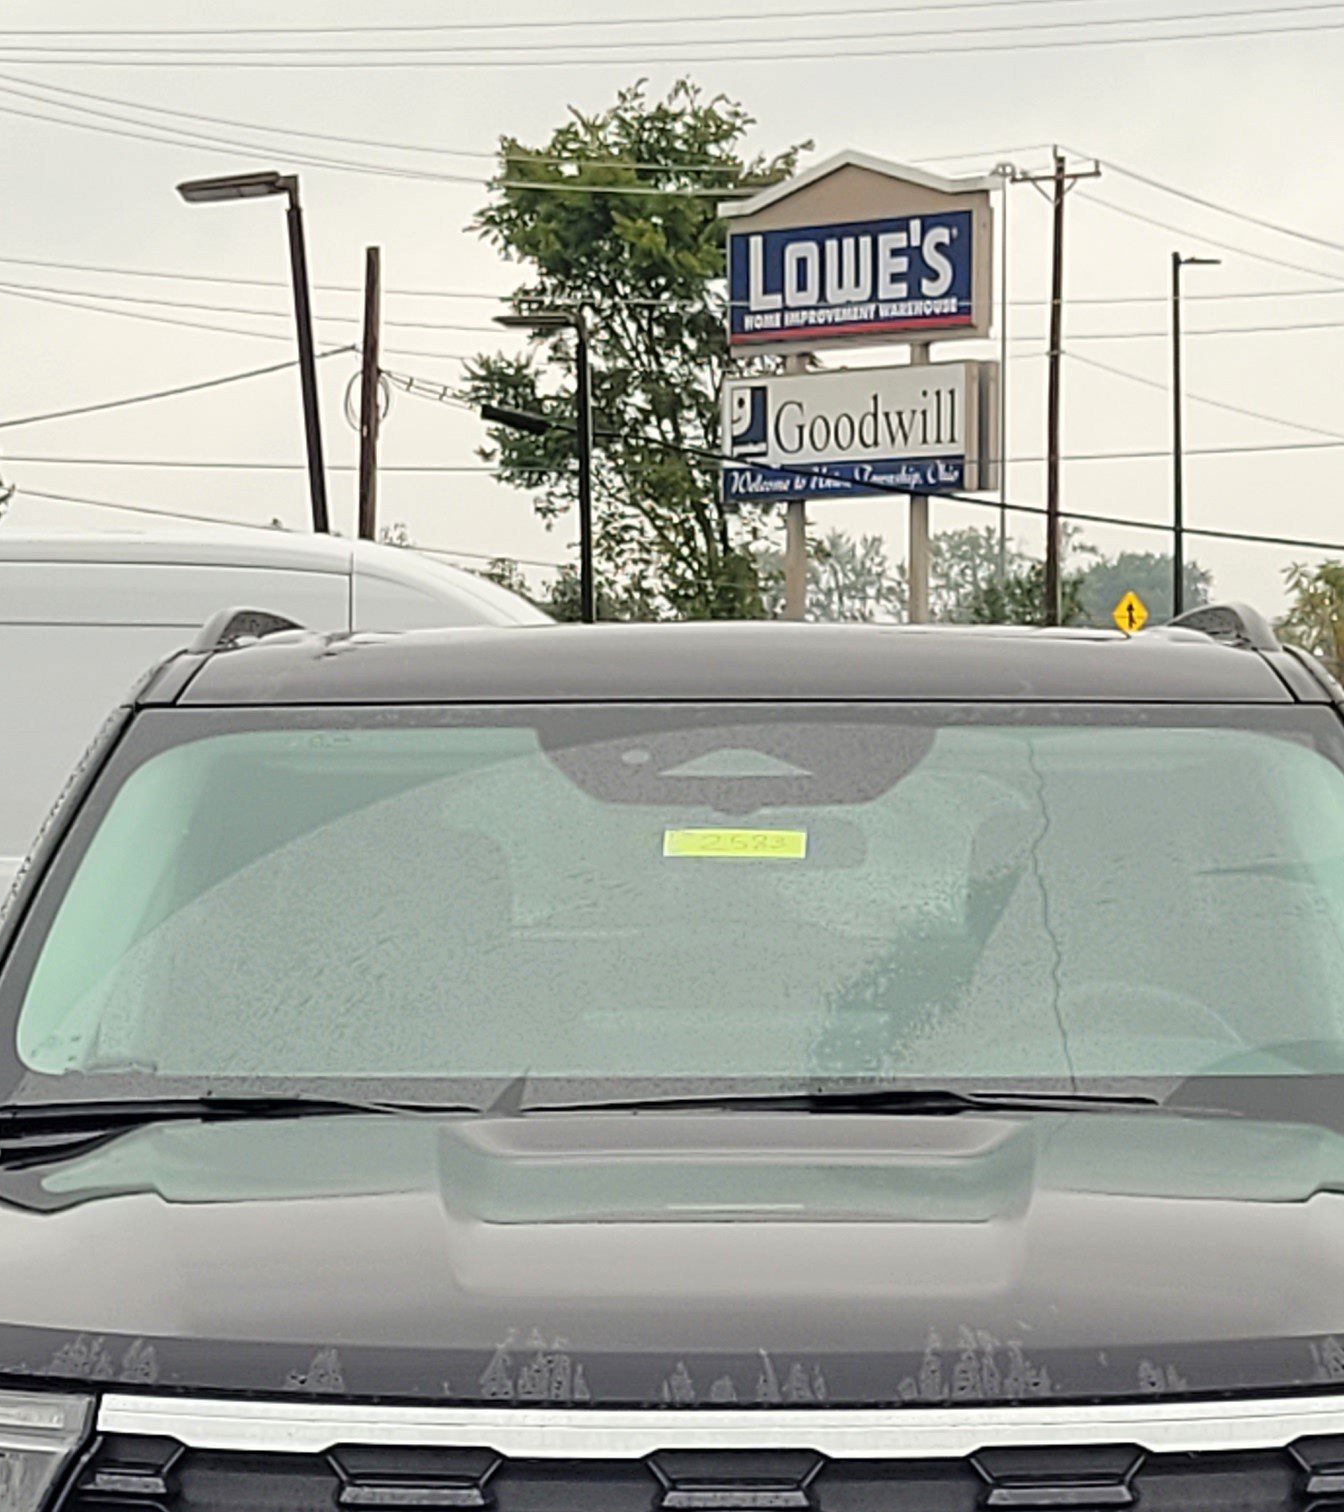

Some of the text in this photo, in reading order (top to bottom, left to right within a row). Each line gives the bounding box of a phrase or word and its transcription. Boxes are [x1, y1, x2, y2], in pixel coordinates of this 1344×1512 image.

[748, 218, 954, 311] LOWE'S
[743, 297, 958, 331] HOME IMPROVEMENT WAREHOUSE
[773, 387, 958, 454] Goodwill
